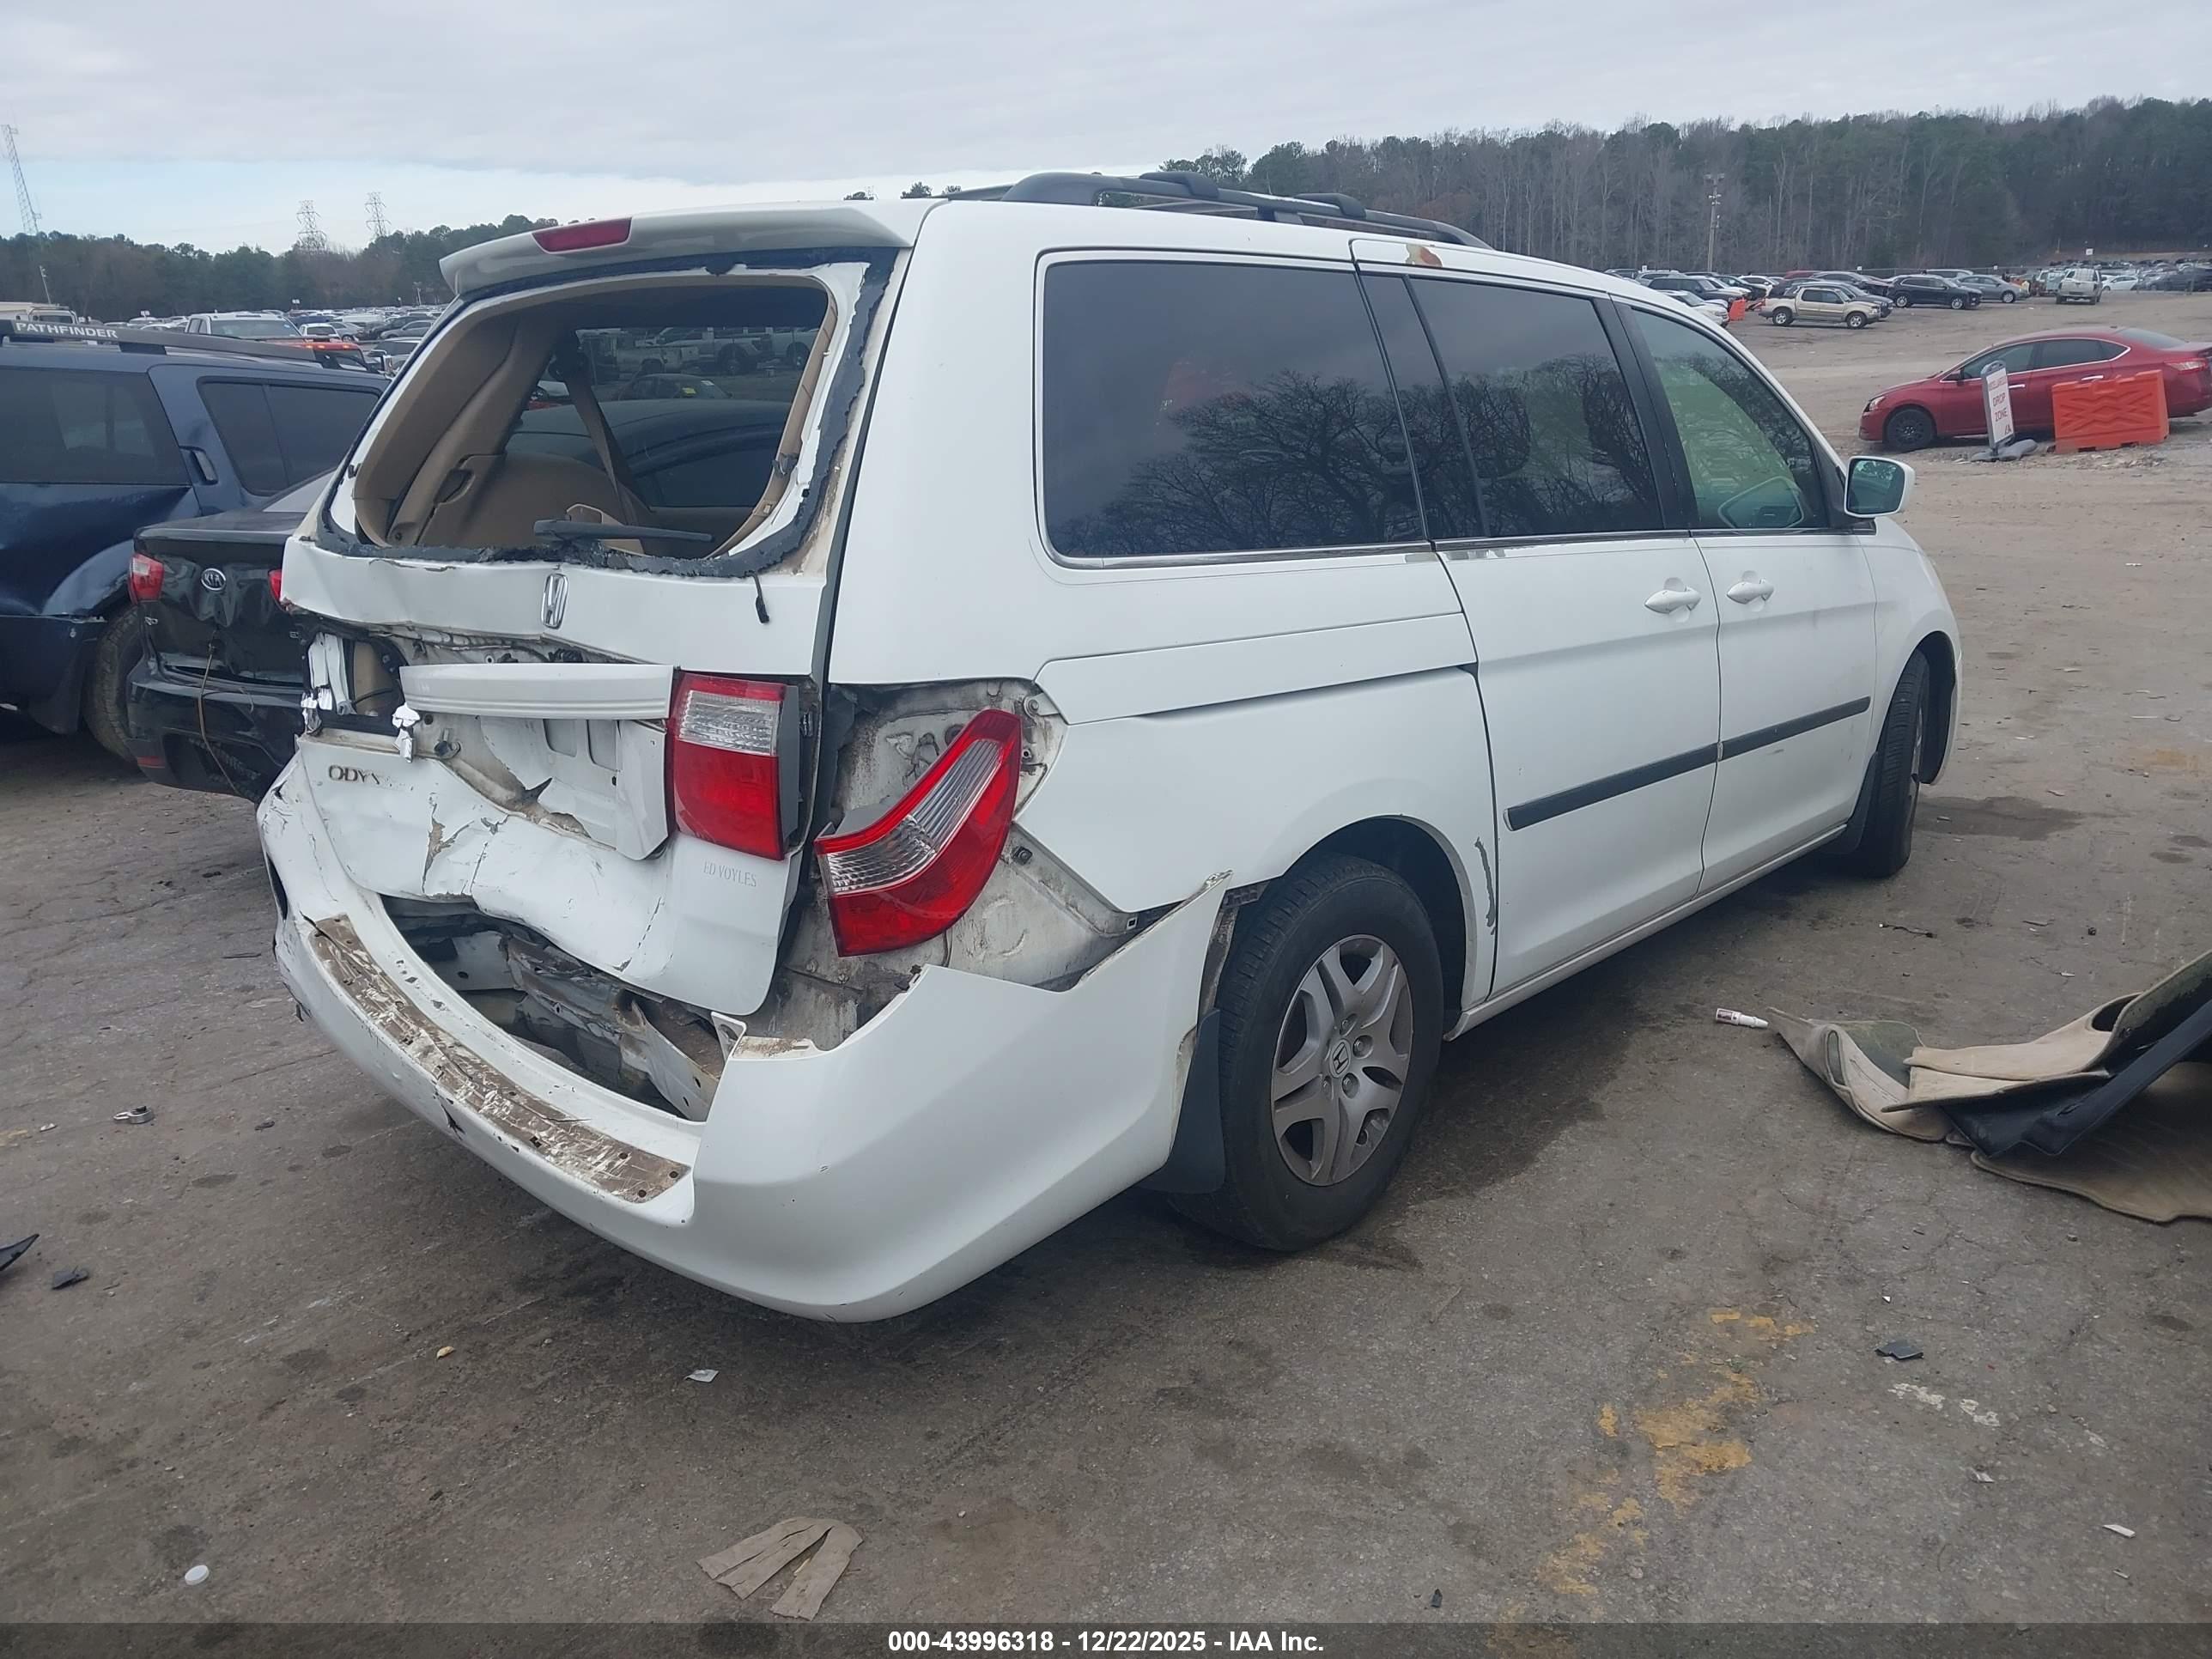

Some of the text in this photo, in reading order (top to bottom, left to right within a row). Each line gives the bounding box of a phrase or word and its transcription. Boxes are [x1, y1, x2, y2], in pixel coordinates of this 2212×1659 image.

[15, 322, 118, 338] PATHFINDER
[204, 571, 223, 587] KIA
[703, 861, 757, 887] ED VOYLES
